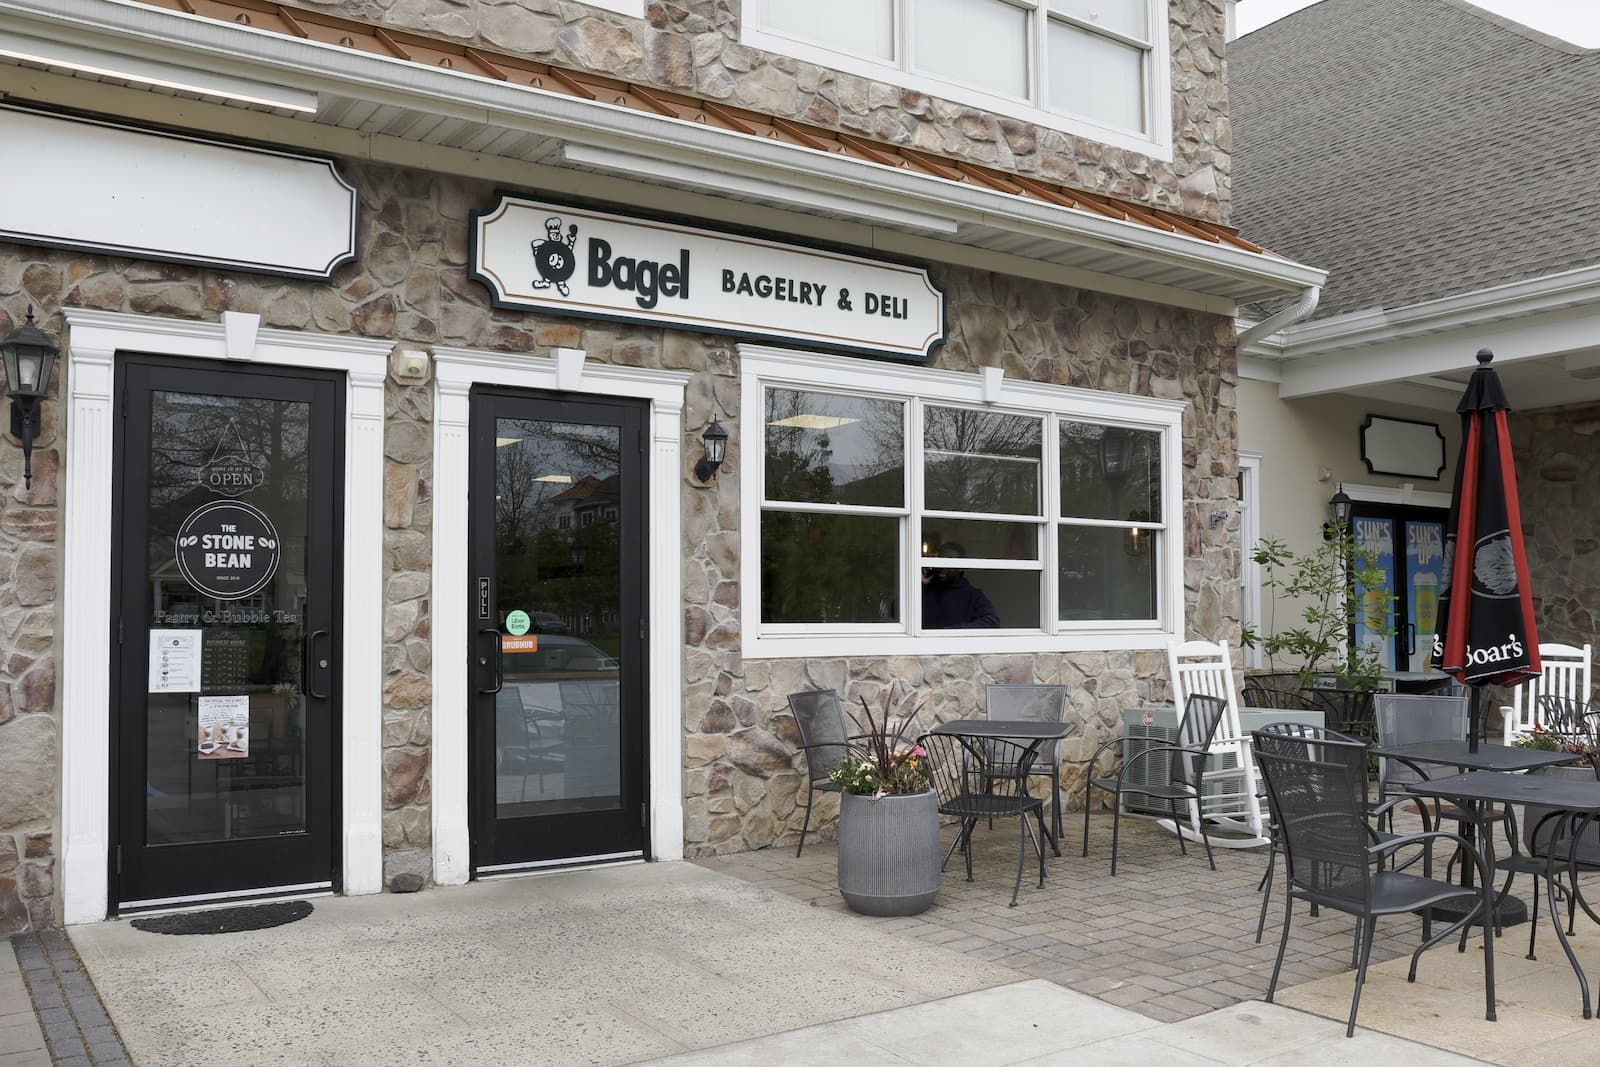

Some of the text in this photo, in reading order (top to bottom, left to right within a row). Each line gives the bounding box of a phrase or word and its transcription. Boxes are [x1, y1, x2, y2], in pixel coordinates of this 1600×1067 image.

[588, 237, 690, 308] Bagel
[721, 269, 908, 320] BAGELRY & DELI
[210, 473, 253, 485] OPEN
[221, 524, 237, 533] THE
[1356, 521, 1391, 541] SUN'S
[1409, 525, 1441, 544] SUN'S
[202, 534, 255, 550] STONE
[205, 553, 251, 568] BEAN
[1418, 545, 1432, 566] UP
[154, 608, 297, 625] Pastry & Bubble Tea
